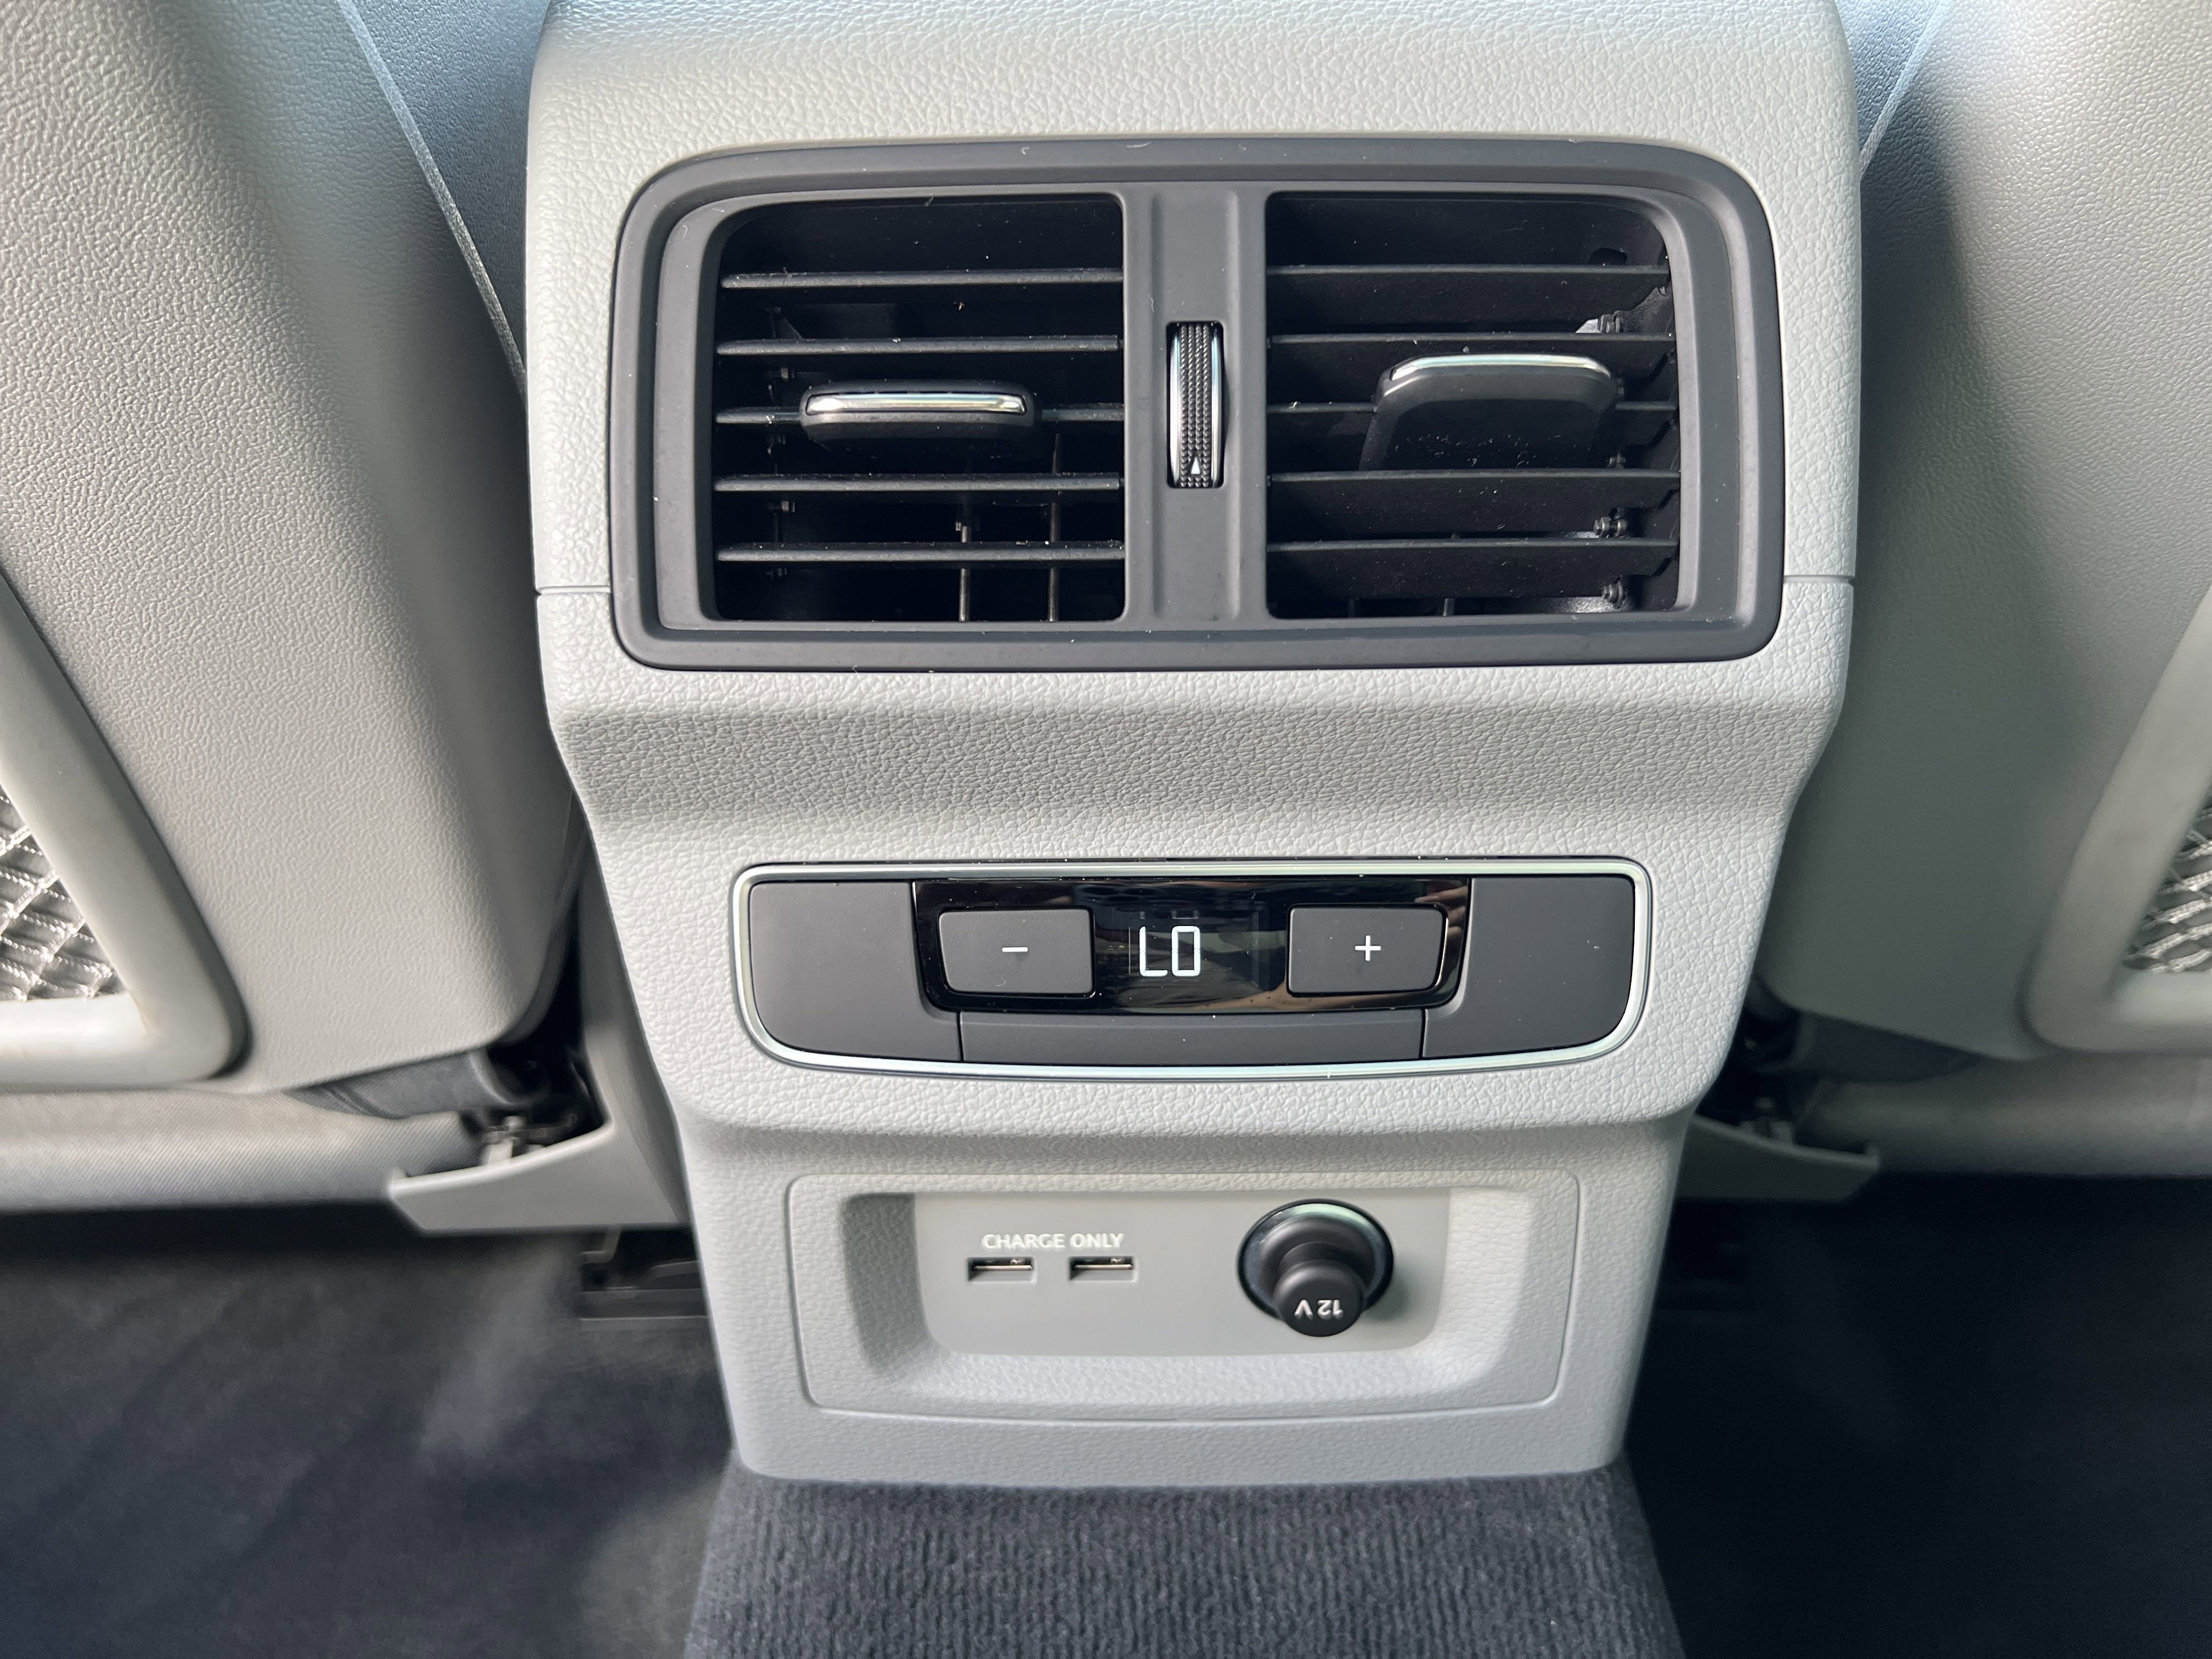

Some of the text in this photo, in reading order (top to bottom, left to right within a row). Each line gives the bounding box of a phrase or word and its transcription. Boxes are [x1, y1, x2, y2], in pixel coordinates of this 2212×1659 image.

[1139, 925, 1201, 977] LO
[981, 1233, 1124, 1250] CHARGE ONLY
[1294, 1299, 1344, 1320] 12 V
